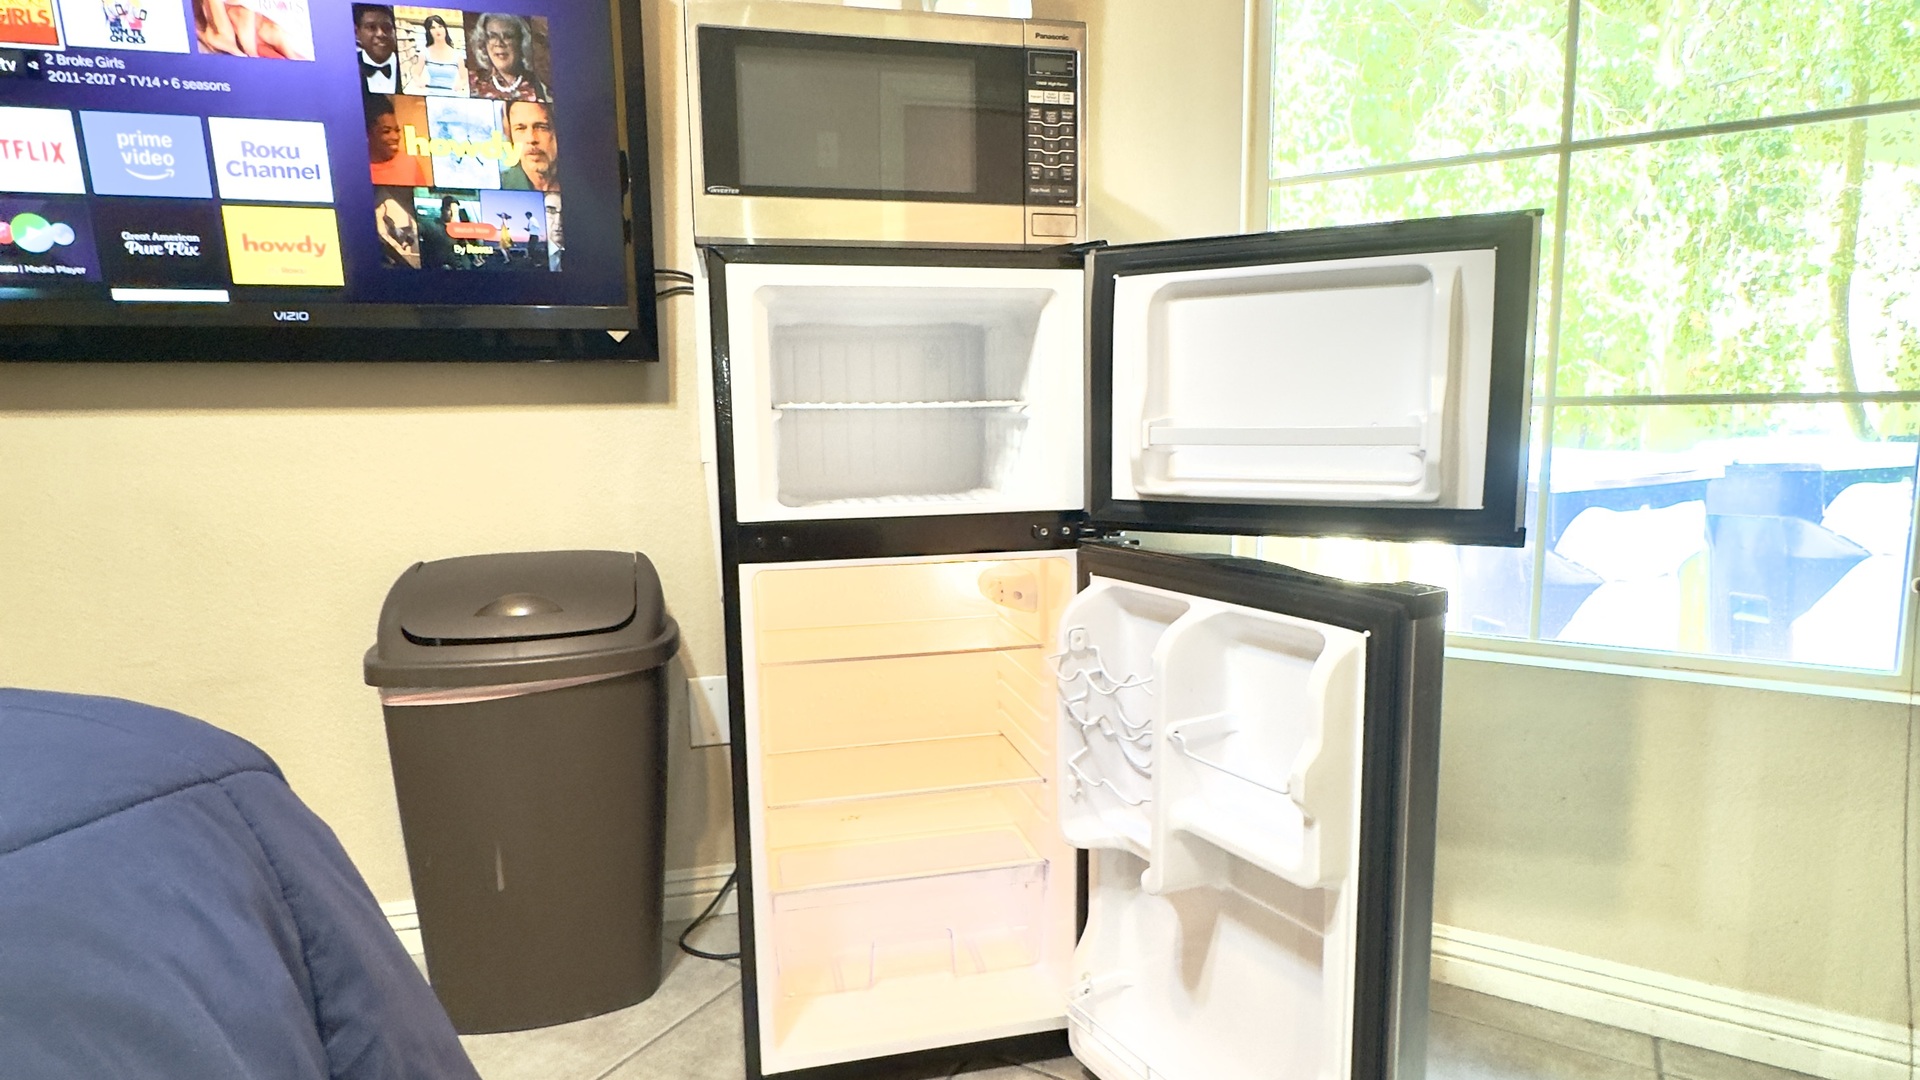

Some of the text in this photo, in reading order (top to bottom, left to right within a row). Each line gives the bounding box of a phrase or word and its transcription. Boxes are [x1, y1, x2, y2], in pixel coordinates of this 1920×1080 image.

[1035, 32, 1070, 41] Panasonic
[44, 53, 126, 69] 2 Broke Girls
[47, 70, 231, 92] 2011-2017 TV14 6 seasons
[116, 130, 172, 150] prime
[403, 123, 524, 168] howdy
[121, 149, 175, 167] video
[241, 140, 301, 160] Roku
[226, 160, 321, 180] Channel
[121, 231, 201, 243] Great American
[241, 233, 327, 258] howdy
[124, 241, 201, 256] Pure Flix
[273, 310, 310, 322] VIZIO
